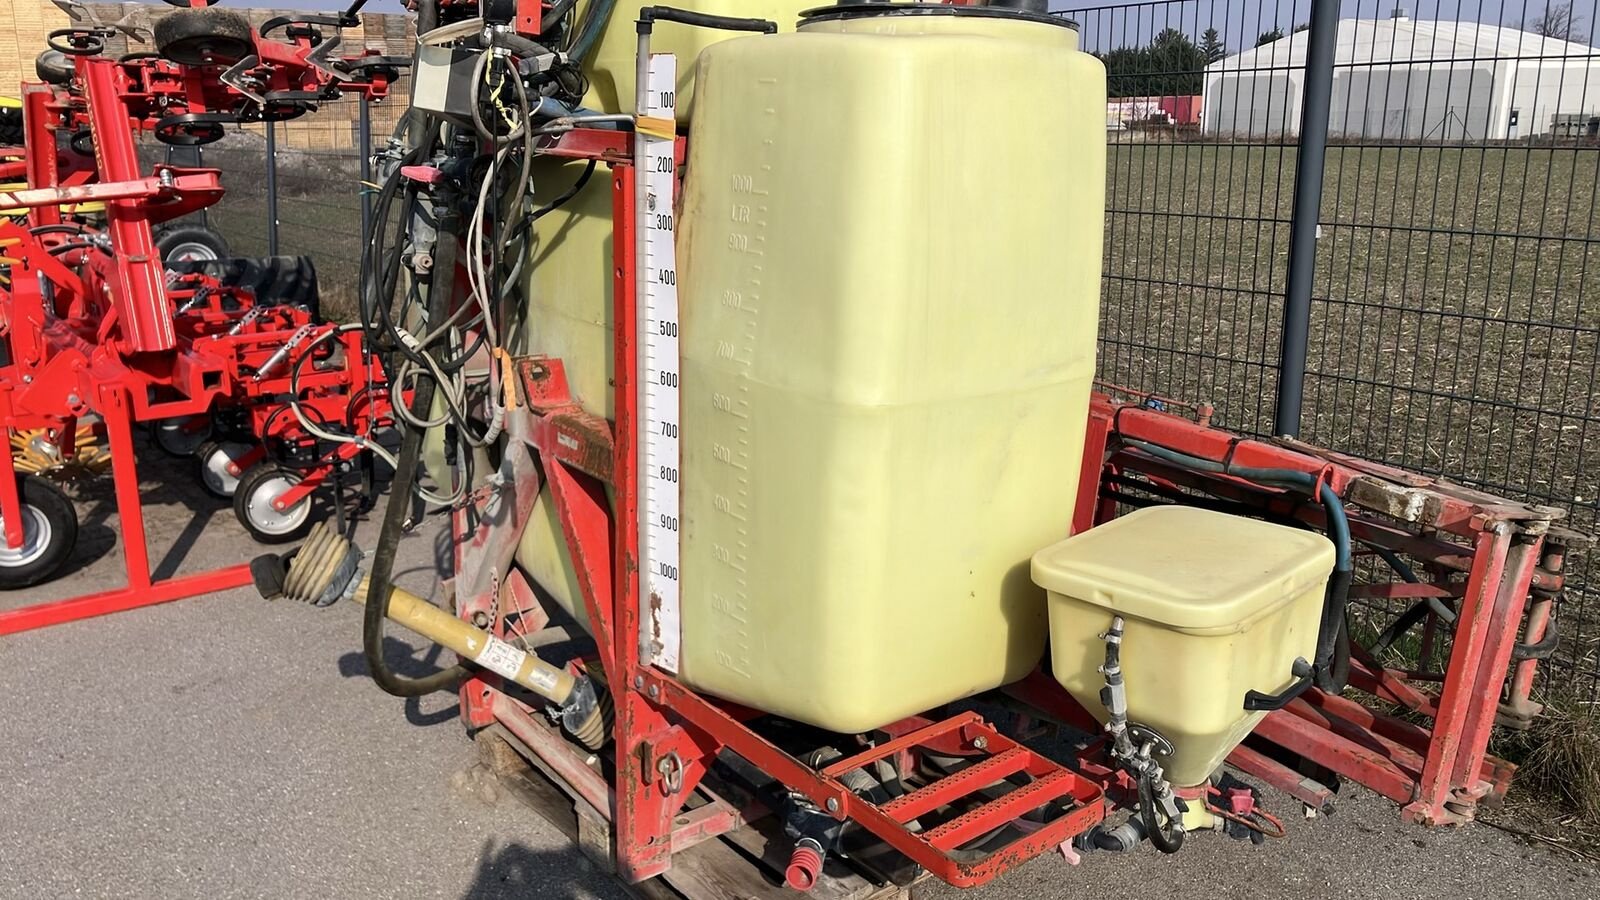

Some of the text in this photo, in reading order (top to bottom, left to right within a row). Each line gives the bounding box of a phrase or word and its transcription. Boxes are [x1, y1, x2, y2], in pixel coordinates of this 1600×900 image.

[660, 92, 674, 108] 100
[83, 75, 102, 169] CHOPSTAR
[657, 156, 672, 174] 200
[732, 175, 752, 192] 1000
[732, 204, 750, 222] LTR
[656, 214, 672, 231] 300
[728, 233, 748, 252] 900
[659, 270, 676, 286] 400
[660, 321, 677, 338] 500
[716, 341, 734, 360] 700
[660, 371, 678, 388] 600
[661, 422, 678, 439] 700
[660, 465, 678, 483] 800
[660, 514, 678, 532] 900
[660, 562, 678, 581] 1000
